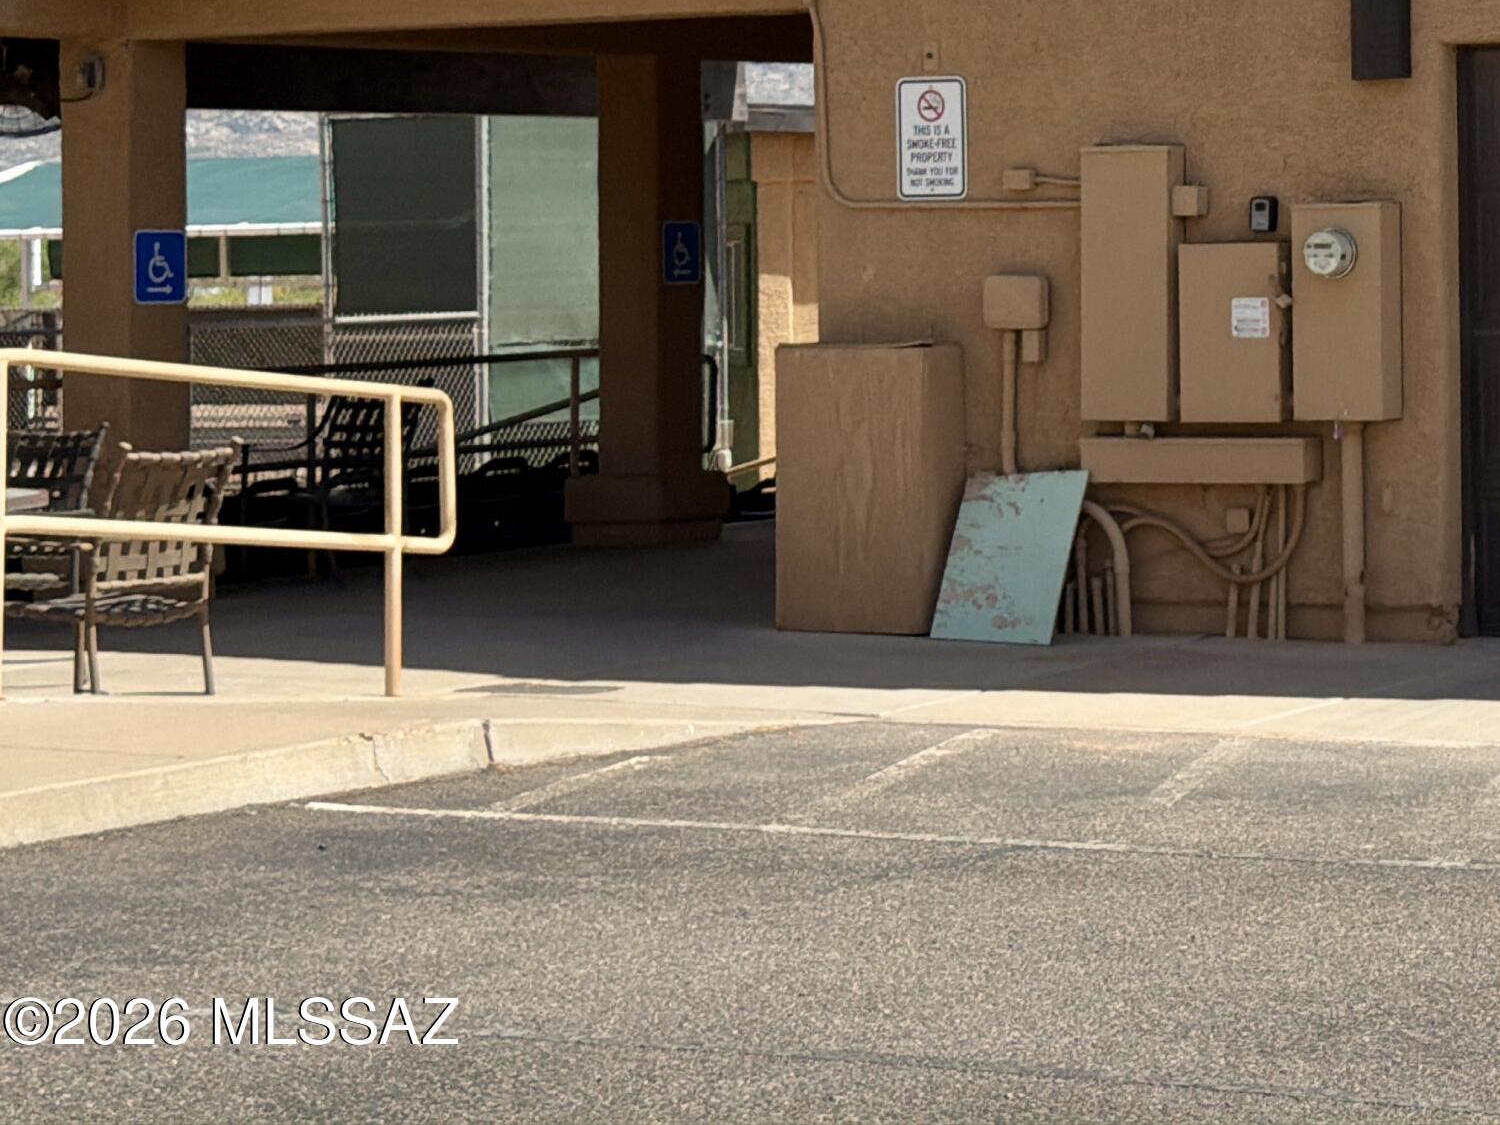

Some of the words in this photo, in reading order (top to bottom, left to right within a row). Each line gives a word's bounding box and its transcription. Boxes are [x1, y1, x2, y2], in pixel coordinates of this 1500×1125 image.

[913, 125, 931, 136] THIS
[933, 124, 942, 135] IS
[944, 124, 950, 135] A
[906, 137, 957, 150] SMOKE-FREE
[910, 151, 953, 163] PROPERTY
[906, 167, 928, 176] THANK
[930, 167, 942, 176] YOU
[945, 166, 958, 175] FOR
[910, 178, 924, 187] NOT
[925, 177, 954, 187] SMOKING
